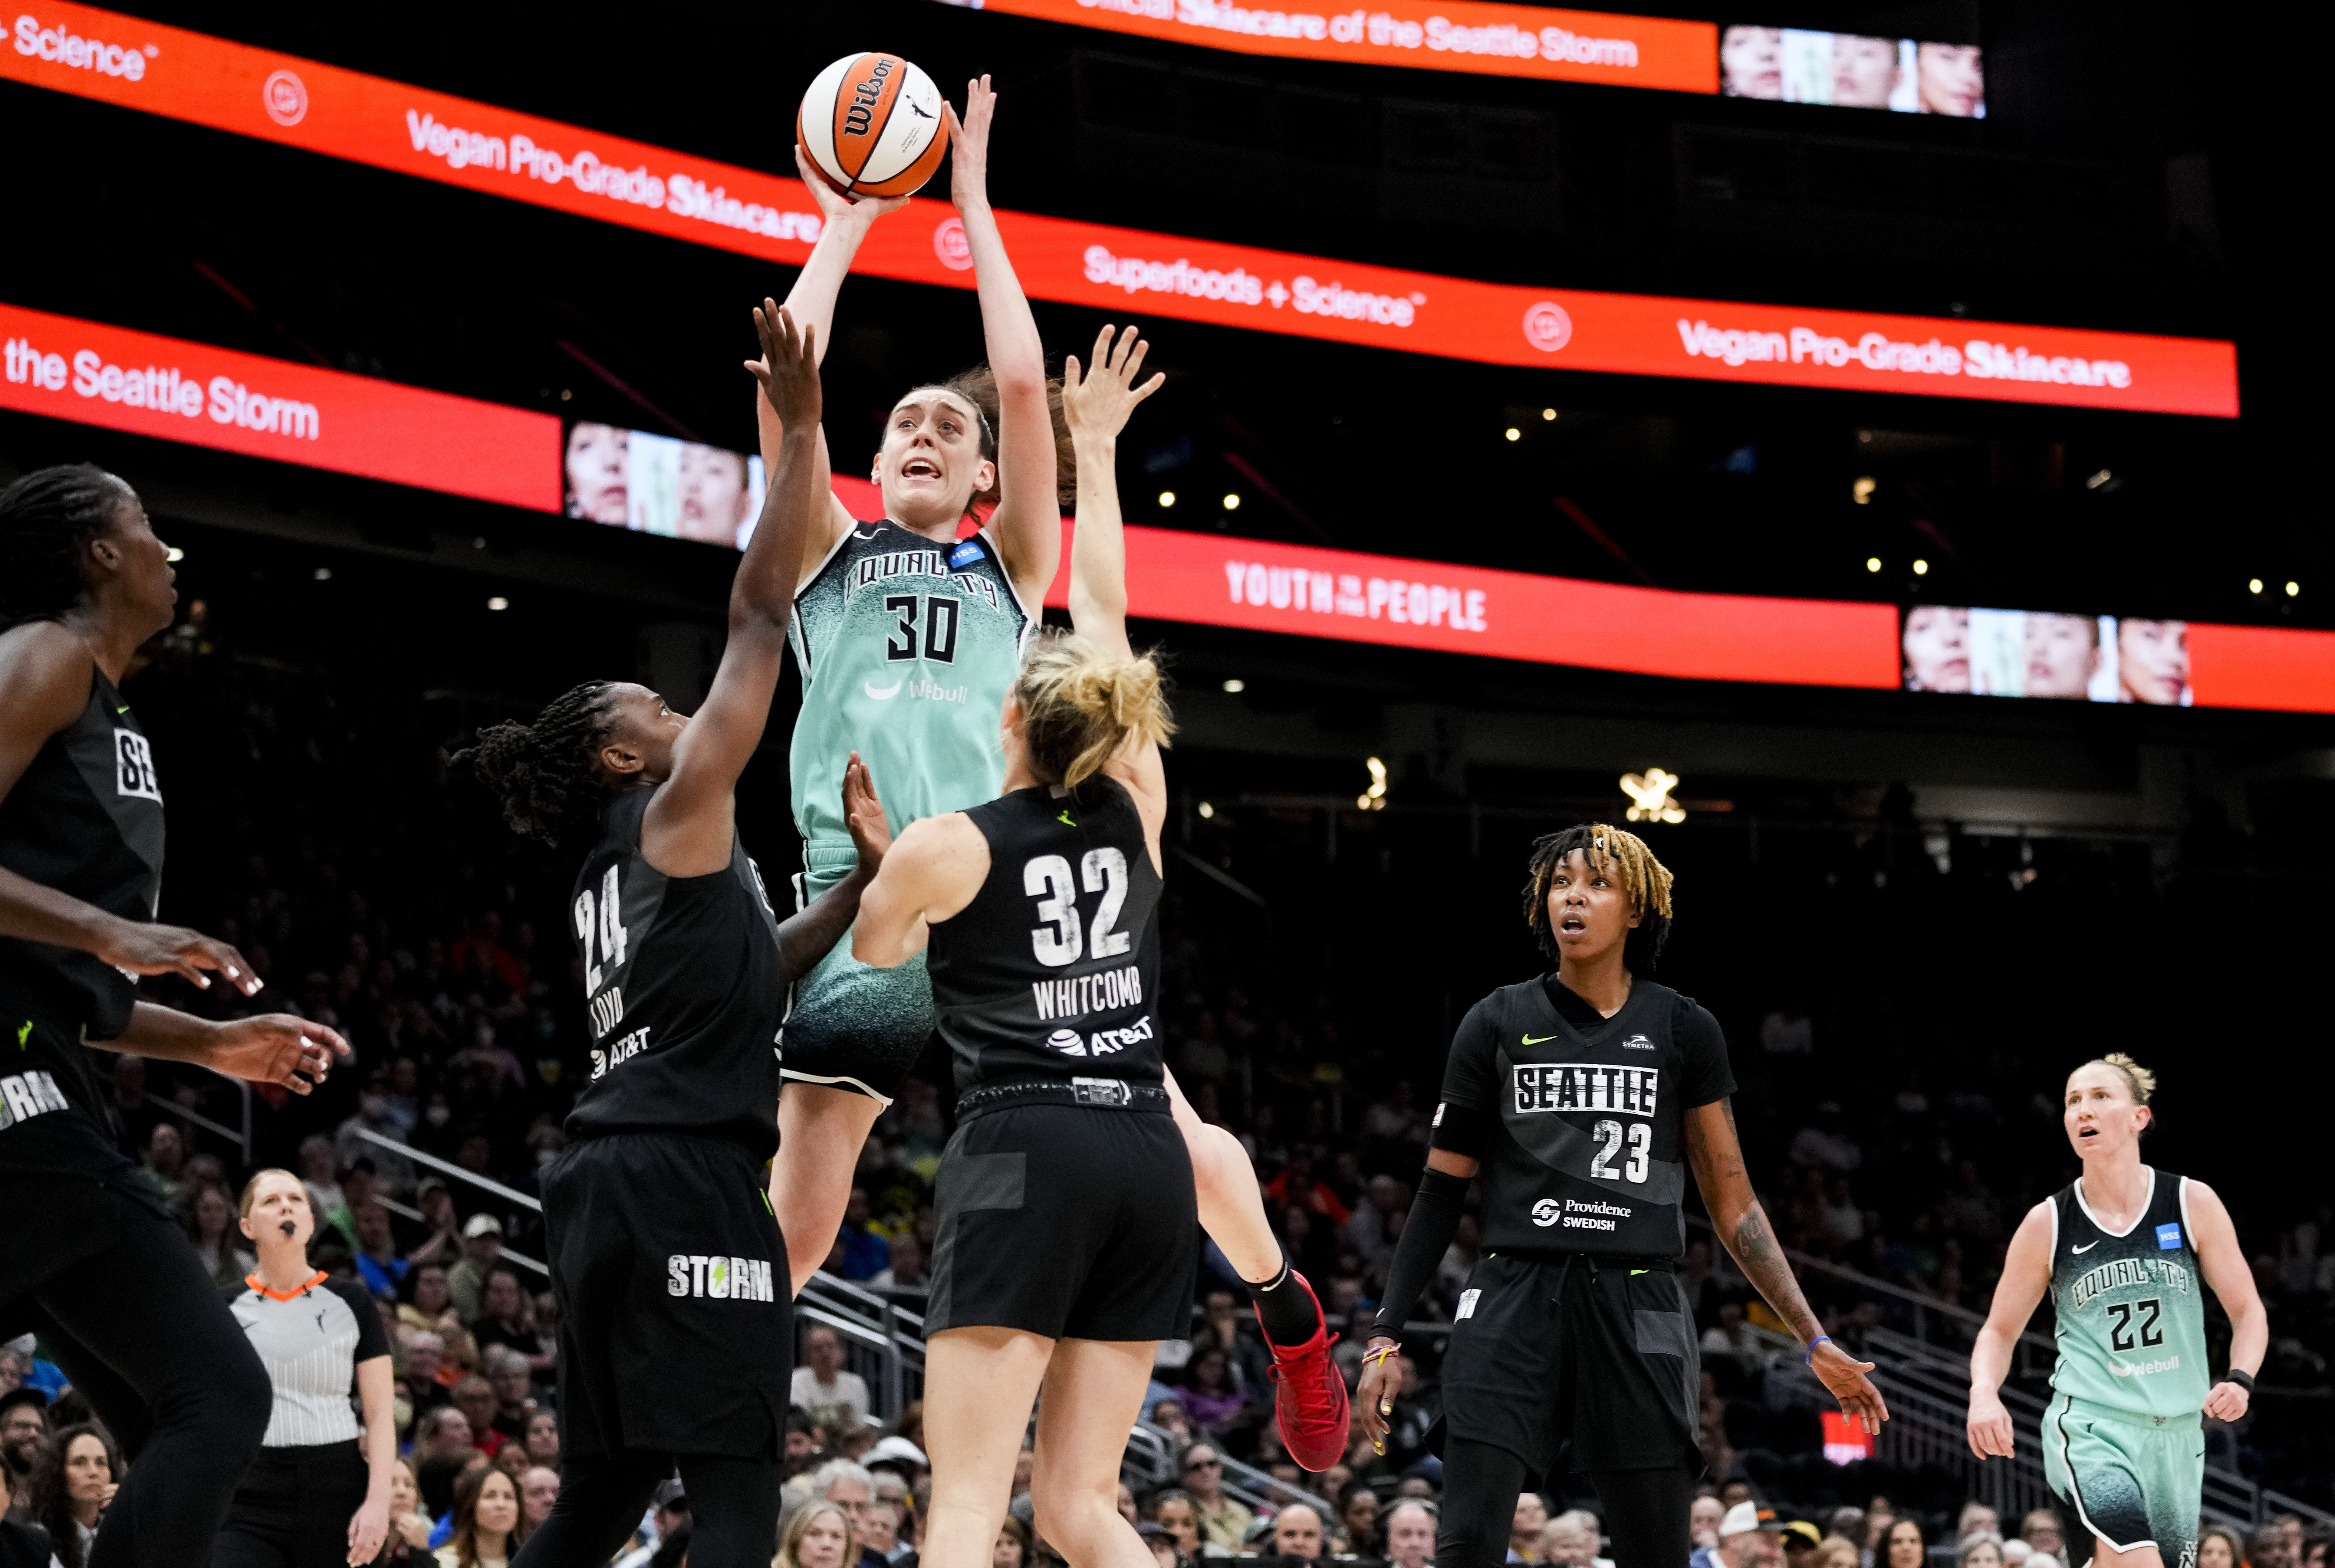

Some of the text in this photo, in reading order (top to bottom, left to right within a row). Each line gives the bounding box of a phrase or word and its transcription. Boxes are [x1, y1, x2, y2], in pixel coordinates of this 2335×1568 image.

[1175, 0, 1327, 40] Skincare
[1329, 10, 1367, 43] of
[1368, 13, 1423, 48] the
[1425, 17, 1538, 58] Seattle
[1540, 27, 1638, 67] Storm
[844, 57, 897, 138] Wilson
[407, 109, 822, 243] Vegan Pro-Grade Skincare
[1084, 246, 1263, 306] Superfoods
[1677, 320, 2132, 388] Vegan Pro-Grade Skincare
[4, 338, 319, 441] the Seattle Storm
[1224, 560, 1334, 614] YOUTH
[1367, 577, 1487, 632] PEOPLE
[884, 594, 962, 665] 30
[575, 864, 627, 999] 24
[1023, 847, 1131, 967] 32
[590, 986, 624, 1038] LOYD
[1033, 966, 1142, 1021] WHITCOMB
[609, 1026, 650, 1070] AT&T
[1091, 1016, 1154, 1056] AT&T
[1517, 1066, 1655, 1114] SEATTLE
[1591, 1120, 1652, 1183] 23
[1563, 1217, 1615, 1231] SWEDISH
[1565, 1199, 1631, 1217] Providence
[668, 1255, 774, 1302] STORM
[2107, 1298, 2164, 1353] 22
[2131, 1356, 2180, 1376] Webull
